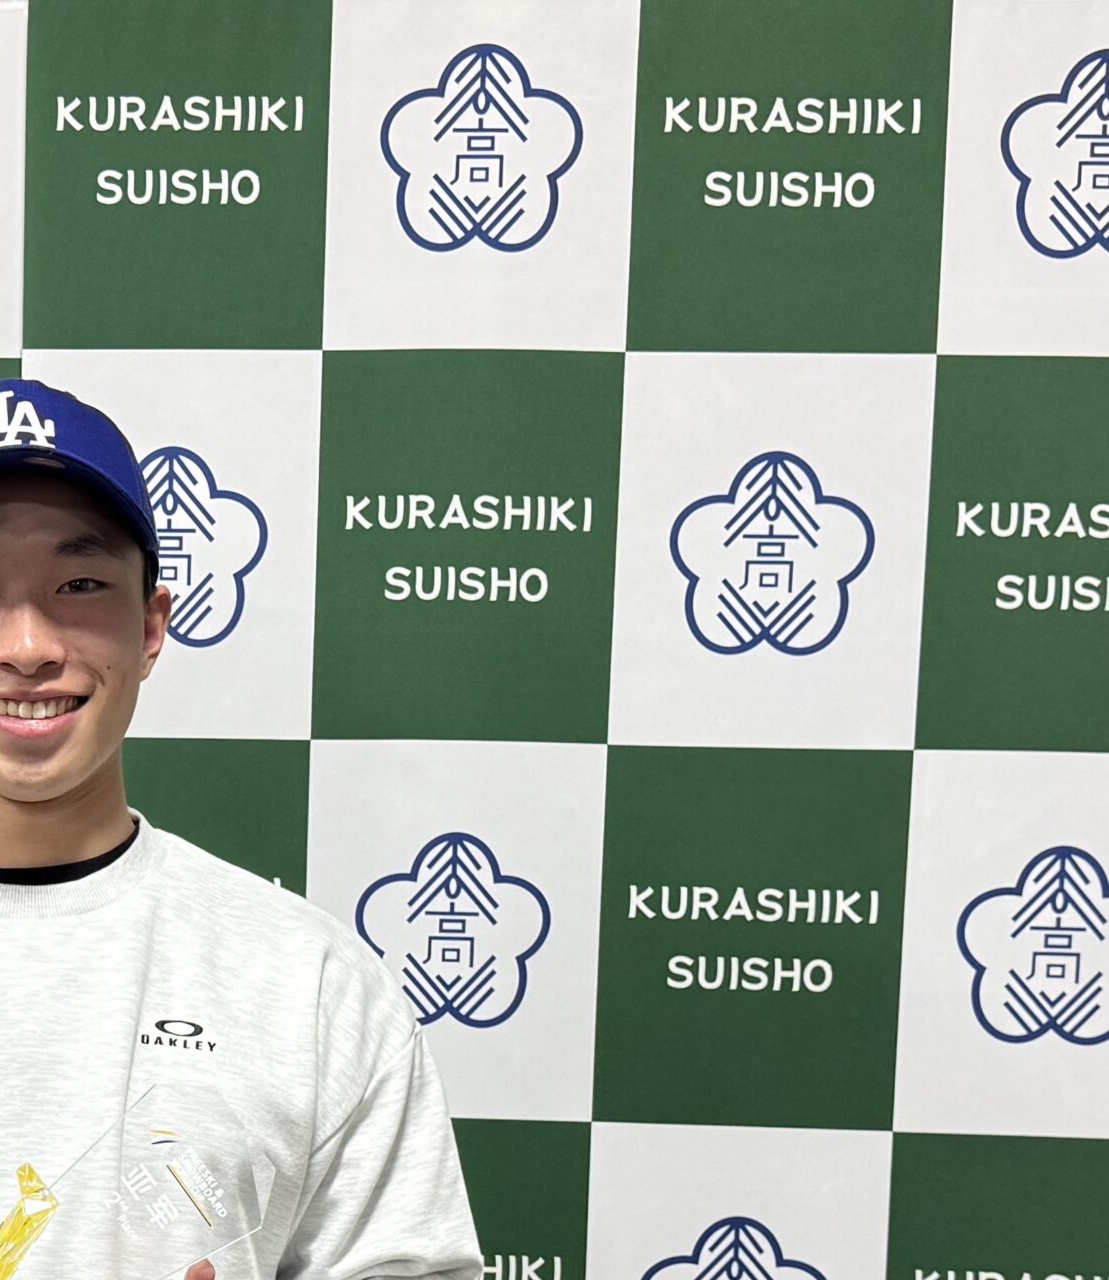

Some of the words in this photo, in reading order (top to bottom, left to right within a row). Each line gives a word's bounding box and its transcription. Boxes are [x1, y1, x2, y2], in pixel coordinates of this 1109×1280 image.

[55, 94, 304, 132] KURASHIKI
[663, 96, 922, 135] KURASHIKI
[96, 168, 261, 205] SUISHO
[703, 170, 875, 208] SUISHO
[344, 493, 593, 533] KURASHIKI
[384, 565, 549, 603] SUISHO
[628, 884, 879, 925] KURASHIKI
[666, 955, 833, 993] SUISHO
[140, 1033, 217, 1052] OAKLEY
[178, 1153, 227, 1218] SNOWBOARD
